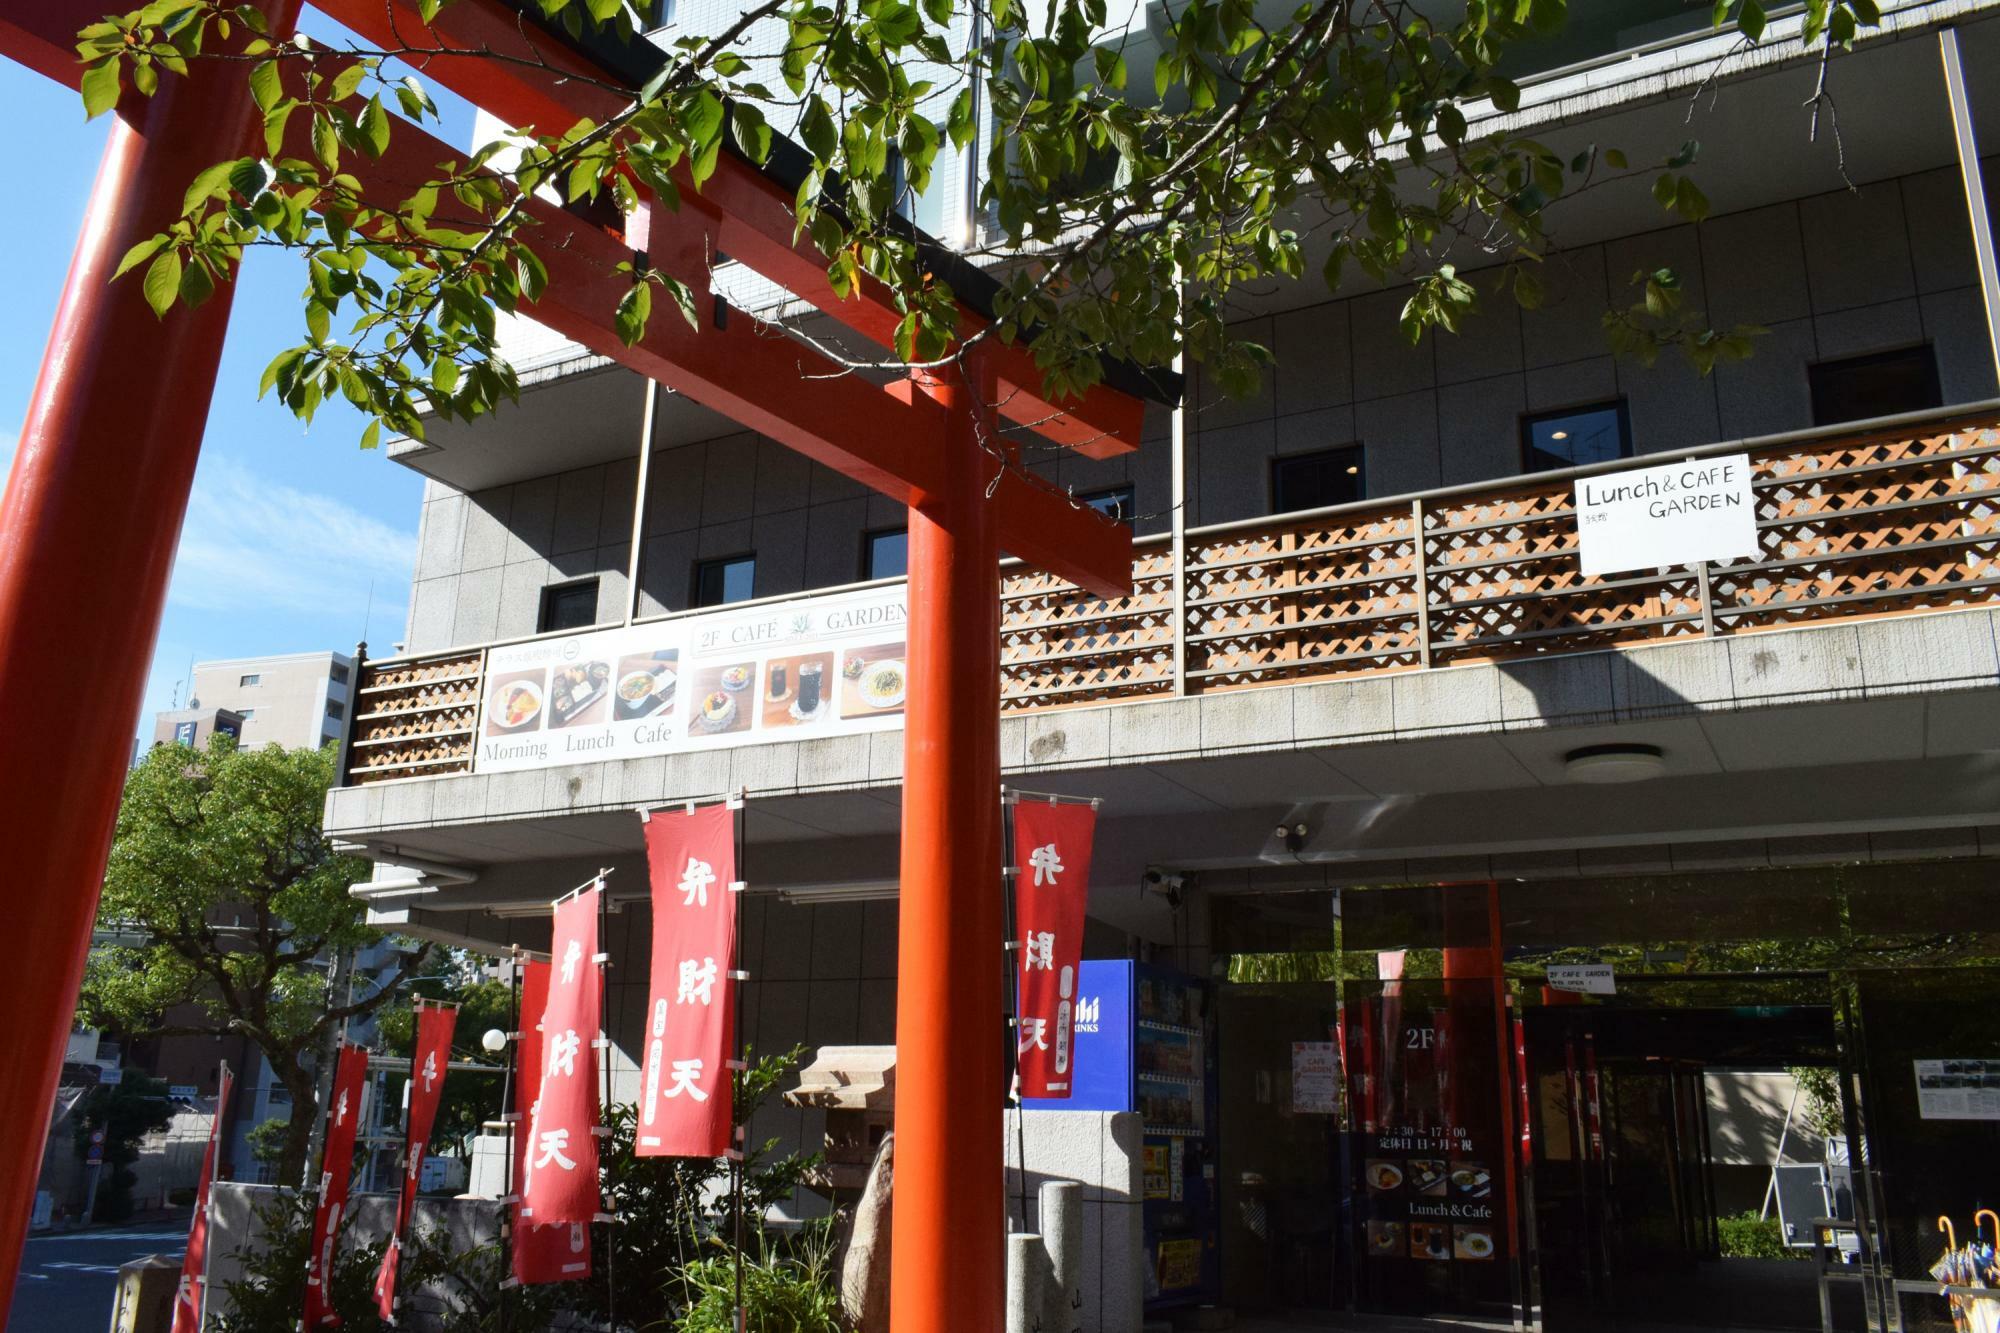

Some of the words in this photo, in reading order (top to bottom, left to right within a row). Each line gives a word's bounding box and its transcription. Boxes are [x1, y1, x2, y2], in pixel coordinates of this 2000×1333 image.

[1649, 492, 1740, 518] GARDEN
[701, 631, 720, 648] 2F
[826, 603, 907, 630] GARDEN
[483, 741, 548, 763] Morning
[565, 729, 614, 753] Lunch
[633, 723, 673, 745] Cafe
[664, 857, 717, 1102] 弁財天
[1406, 1028, 1435, 1049] 2F
[1380, 1138, 1411, 1150] 定休日
